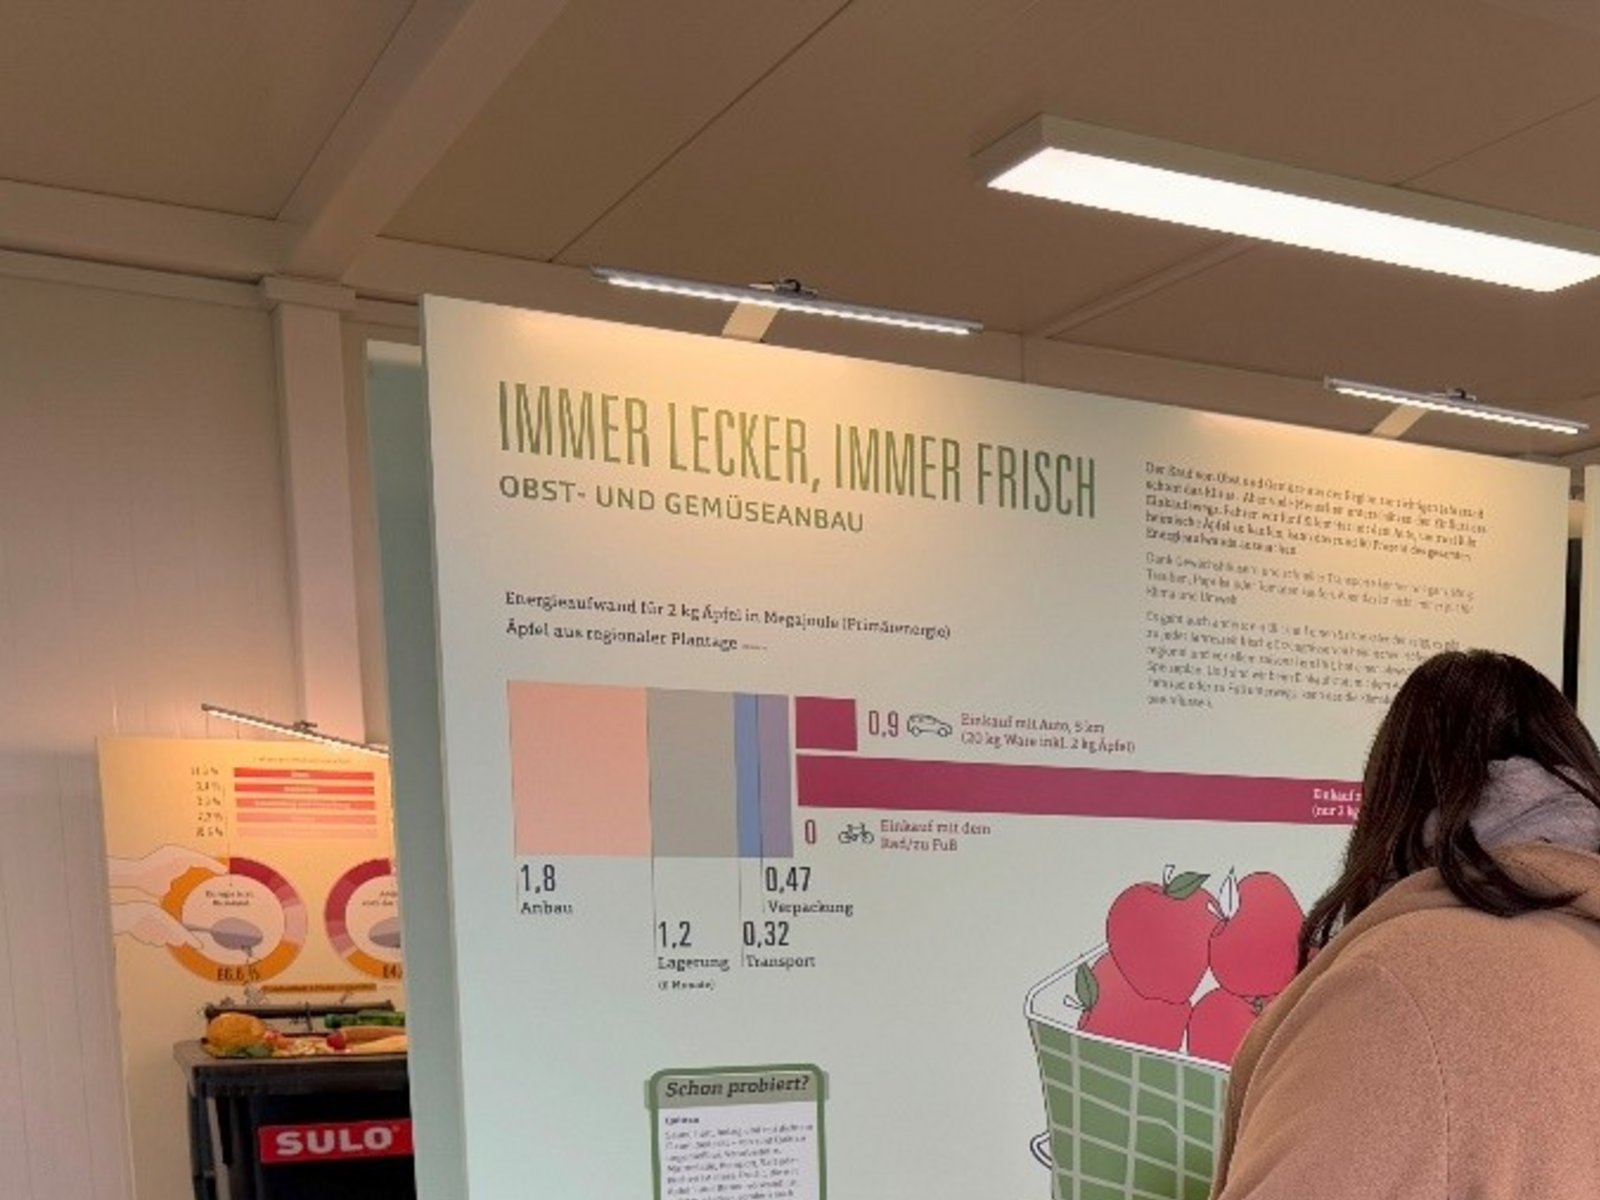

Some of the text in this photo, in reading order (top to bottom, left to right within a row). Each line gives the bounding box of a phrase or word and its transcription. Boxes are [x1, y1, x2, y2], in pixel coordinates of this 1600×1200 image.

[500, 380, 1096, 519] IMMER LECKER, IMMER FRISCH
[499, 475, 864, 533] OBST- UND GEMÜSEANBAU
[640, 600, 663, 617] für
[667, 603, 677, 617] 2
[681, 604, 699, 621] kg
[745, 608, 761, 622] in
[804, 819, 816, 844] 0
[520, 864, 556, 894] 1,8
[765, 866, 811, 894] 0,47
[520, 901, 573, 915] Anbau
[768, 900, 854, 916] Verpackung
[657, 921, 692, 948] 1,2
[742, 921, 790, 948] 0,32
[657, 956, 730, 972] Lagerung
[746, 954, 816, 970] Transport
[665, 1075, 809, 1098] Schon probiert?
[275, 1126, 392, 1156] SULO
